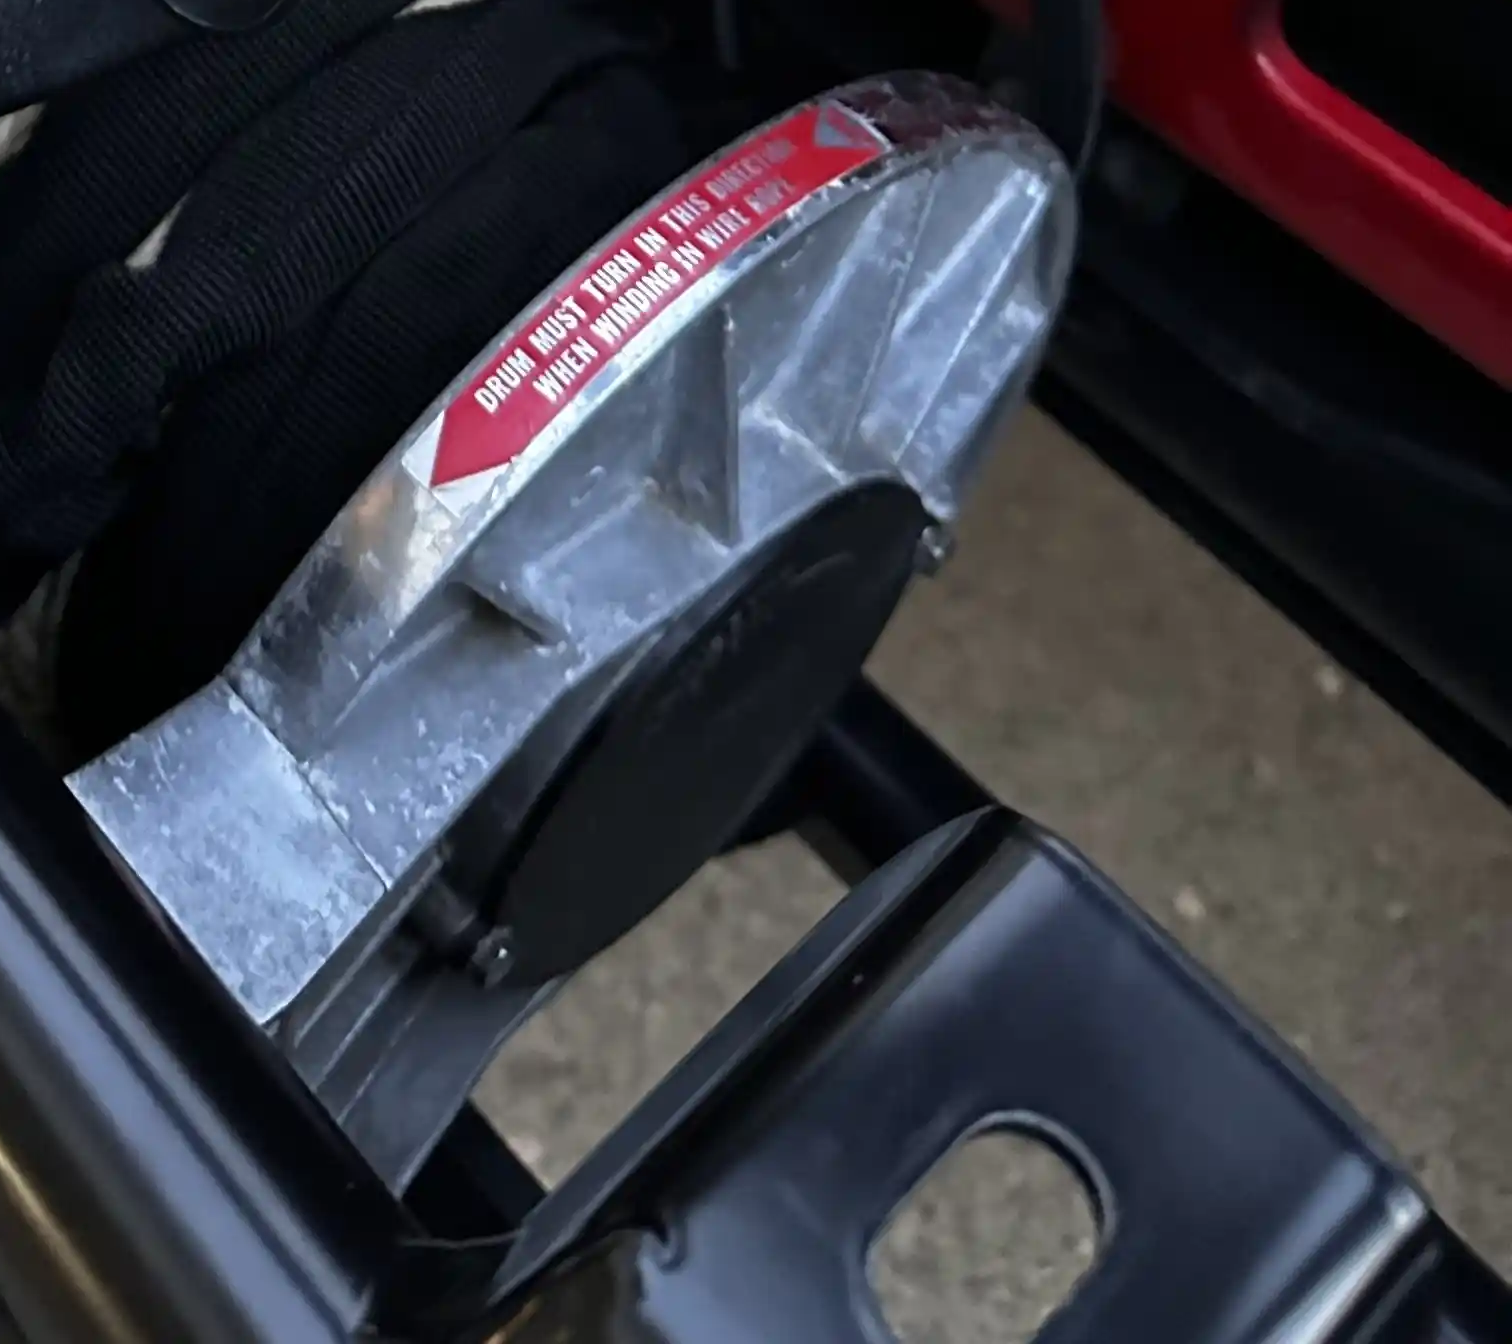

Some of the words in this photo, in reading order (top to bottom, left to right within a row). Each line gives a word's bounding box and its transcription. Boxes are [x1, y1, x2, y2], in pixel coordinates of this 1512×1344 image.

[474, 347, 536, 414] DRUM
[528, 295, 587, 357] MUST
[580, 248, 641, 305] TURN
[633, 225, 668, 258] IN
[659, 192, 711, 234] THIS
[705, 138, 797, 201] DIRECT
[532, 336, 599, 404] WHEN
[590, 260, 682, 348] WINDING
[671, 240, 706, 273] IN
[694, 205, 751, 255] WIRE
